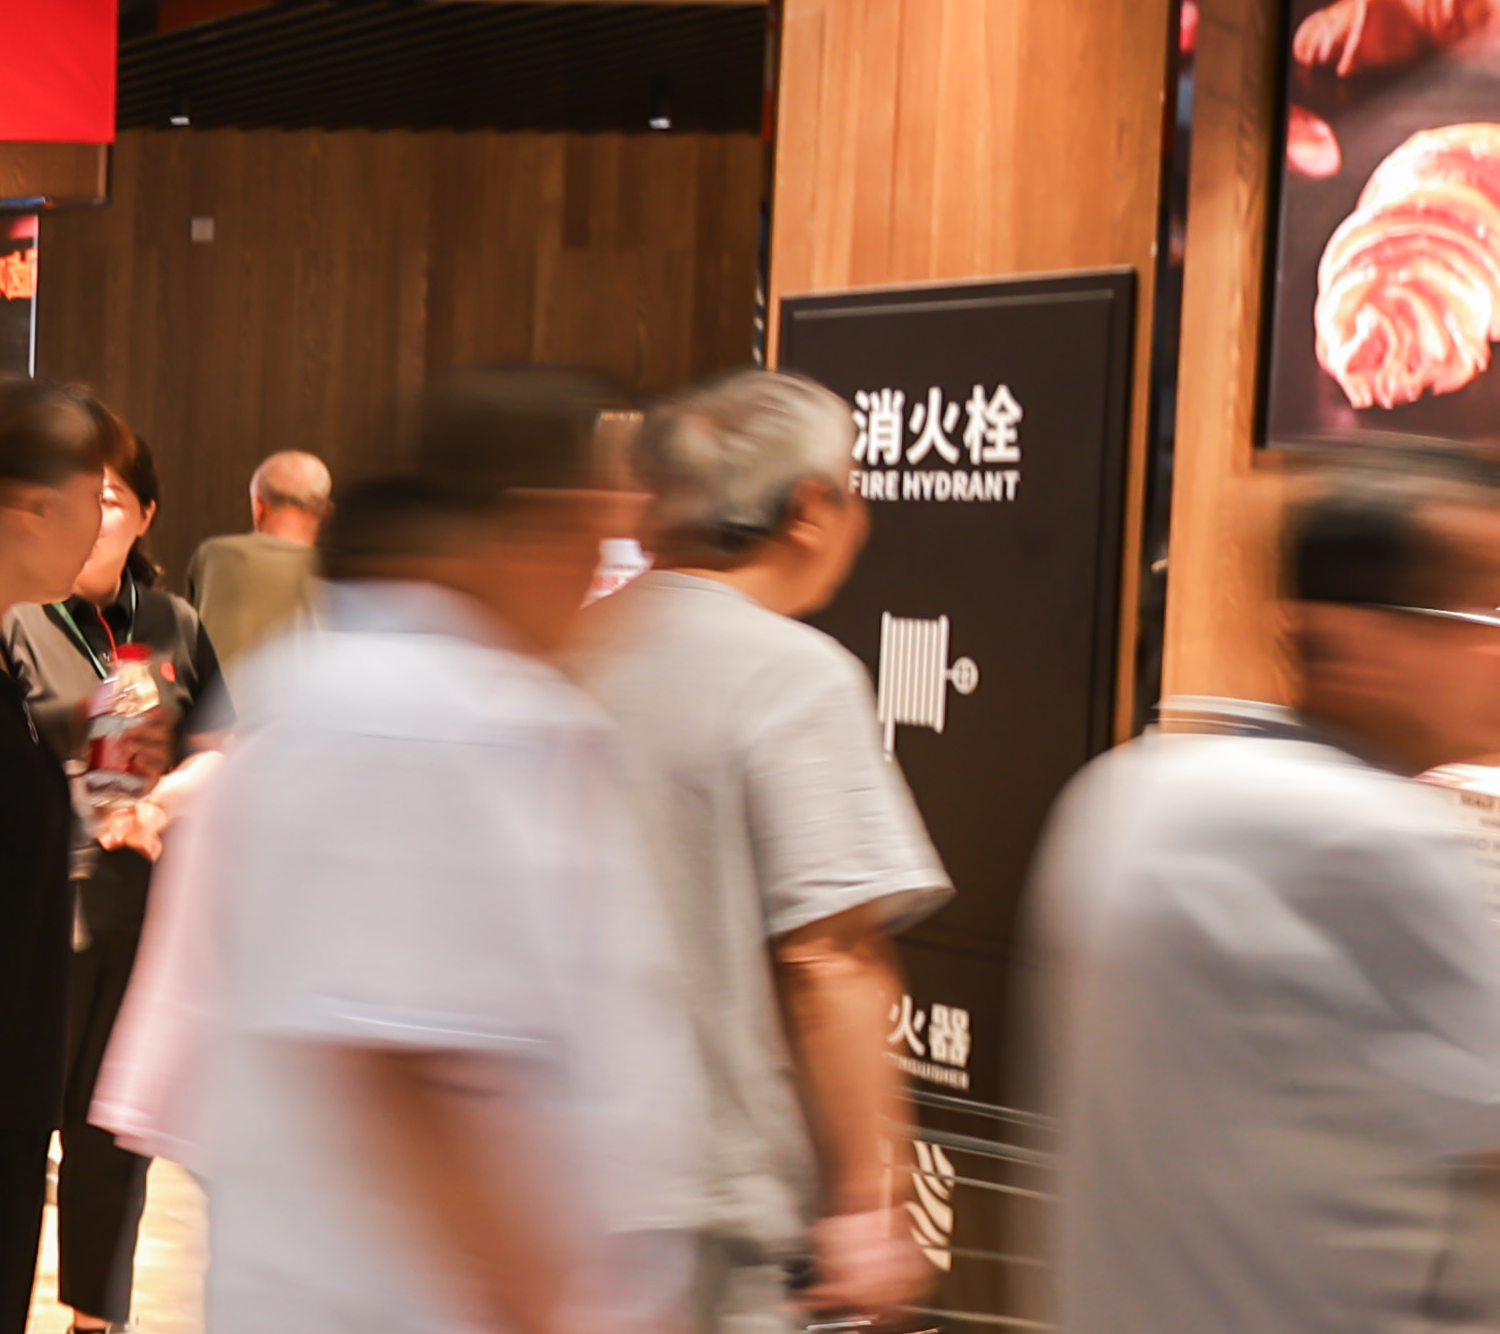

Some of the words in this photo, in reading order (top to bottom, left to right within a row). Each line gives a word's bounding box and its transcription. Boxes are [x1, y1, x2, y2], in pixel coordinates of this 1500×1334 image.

[851, 383, 1023, 466] 消火栓
[849, 470, 900, 502] FIRE
[902, 470, 1021, 502] HYDRANT
